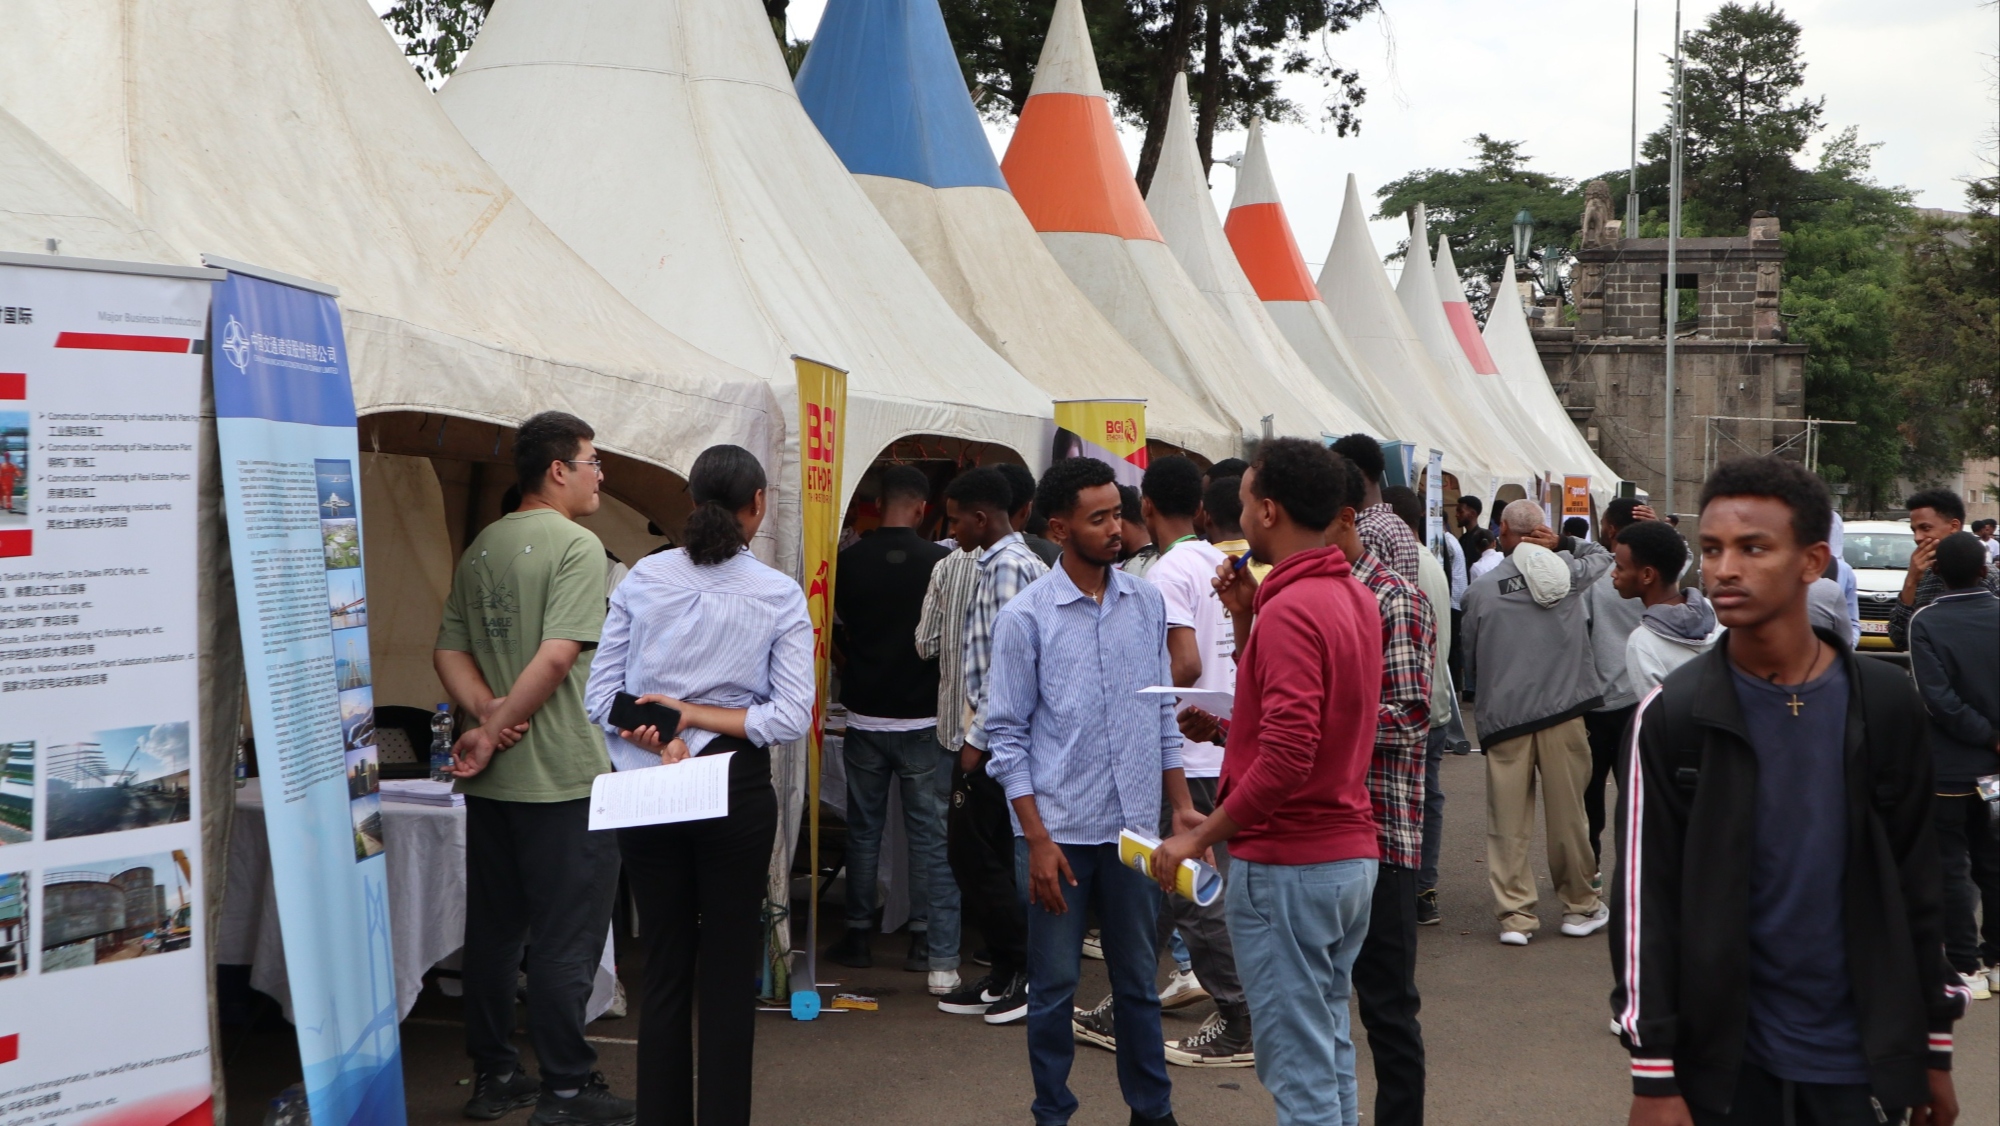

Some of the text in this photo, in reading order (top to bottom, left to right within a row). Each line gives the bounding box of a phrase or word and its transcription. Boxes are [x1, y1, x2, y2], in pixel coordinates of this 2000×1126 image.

[0, 306, 33, 325] 国际
[98, 311, 202, 327] Major Business Introduction
[48, 412, 89, 421] Construction
[90, 412, 128, 422] Contracting
[129, 412, 136, 421] of
[137, 413, 163, 421] Industrial
[1106, 420, 1123, 433] BGI
[806, 402, 836, 464] BGI
[48, 443, 89, 451] Construction
[91, 443, 128, 452] Contracting
[129, 442, 136, 451] of
[137, 443, 151, 451] Steel
[152, 443, 179, 451] Structure
[47, 474, 89, 483] Construction
[91, 473, 128, 483] Contracting
[130, 472, 137, 481] of
[151, 473, 170, 481] Estate
[46, 505, 57, 513] All
[58, 505, 77, 513] other
[78, 504, 91, 513] civil
[92, 504, 131, 514] engineering
[131, 502, 153, 512] related
[68, 570, 82, 579] Dire
[0, 605, 16, 614] lant,
[18, 602, 39, 611] Hebei
[40, 632, 62, 642] Africa
[64, 631, 91, 641] Holding
[104, 627, 132, 638] finishing
[37, 663, 69, 674] National
[71, 660, 99, 671] Cement
